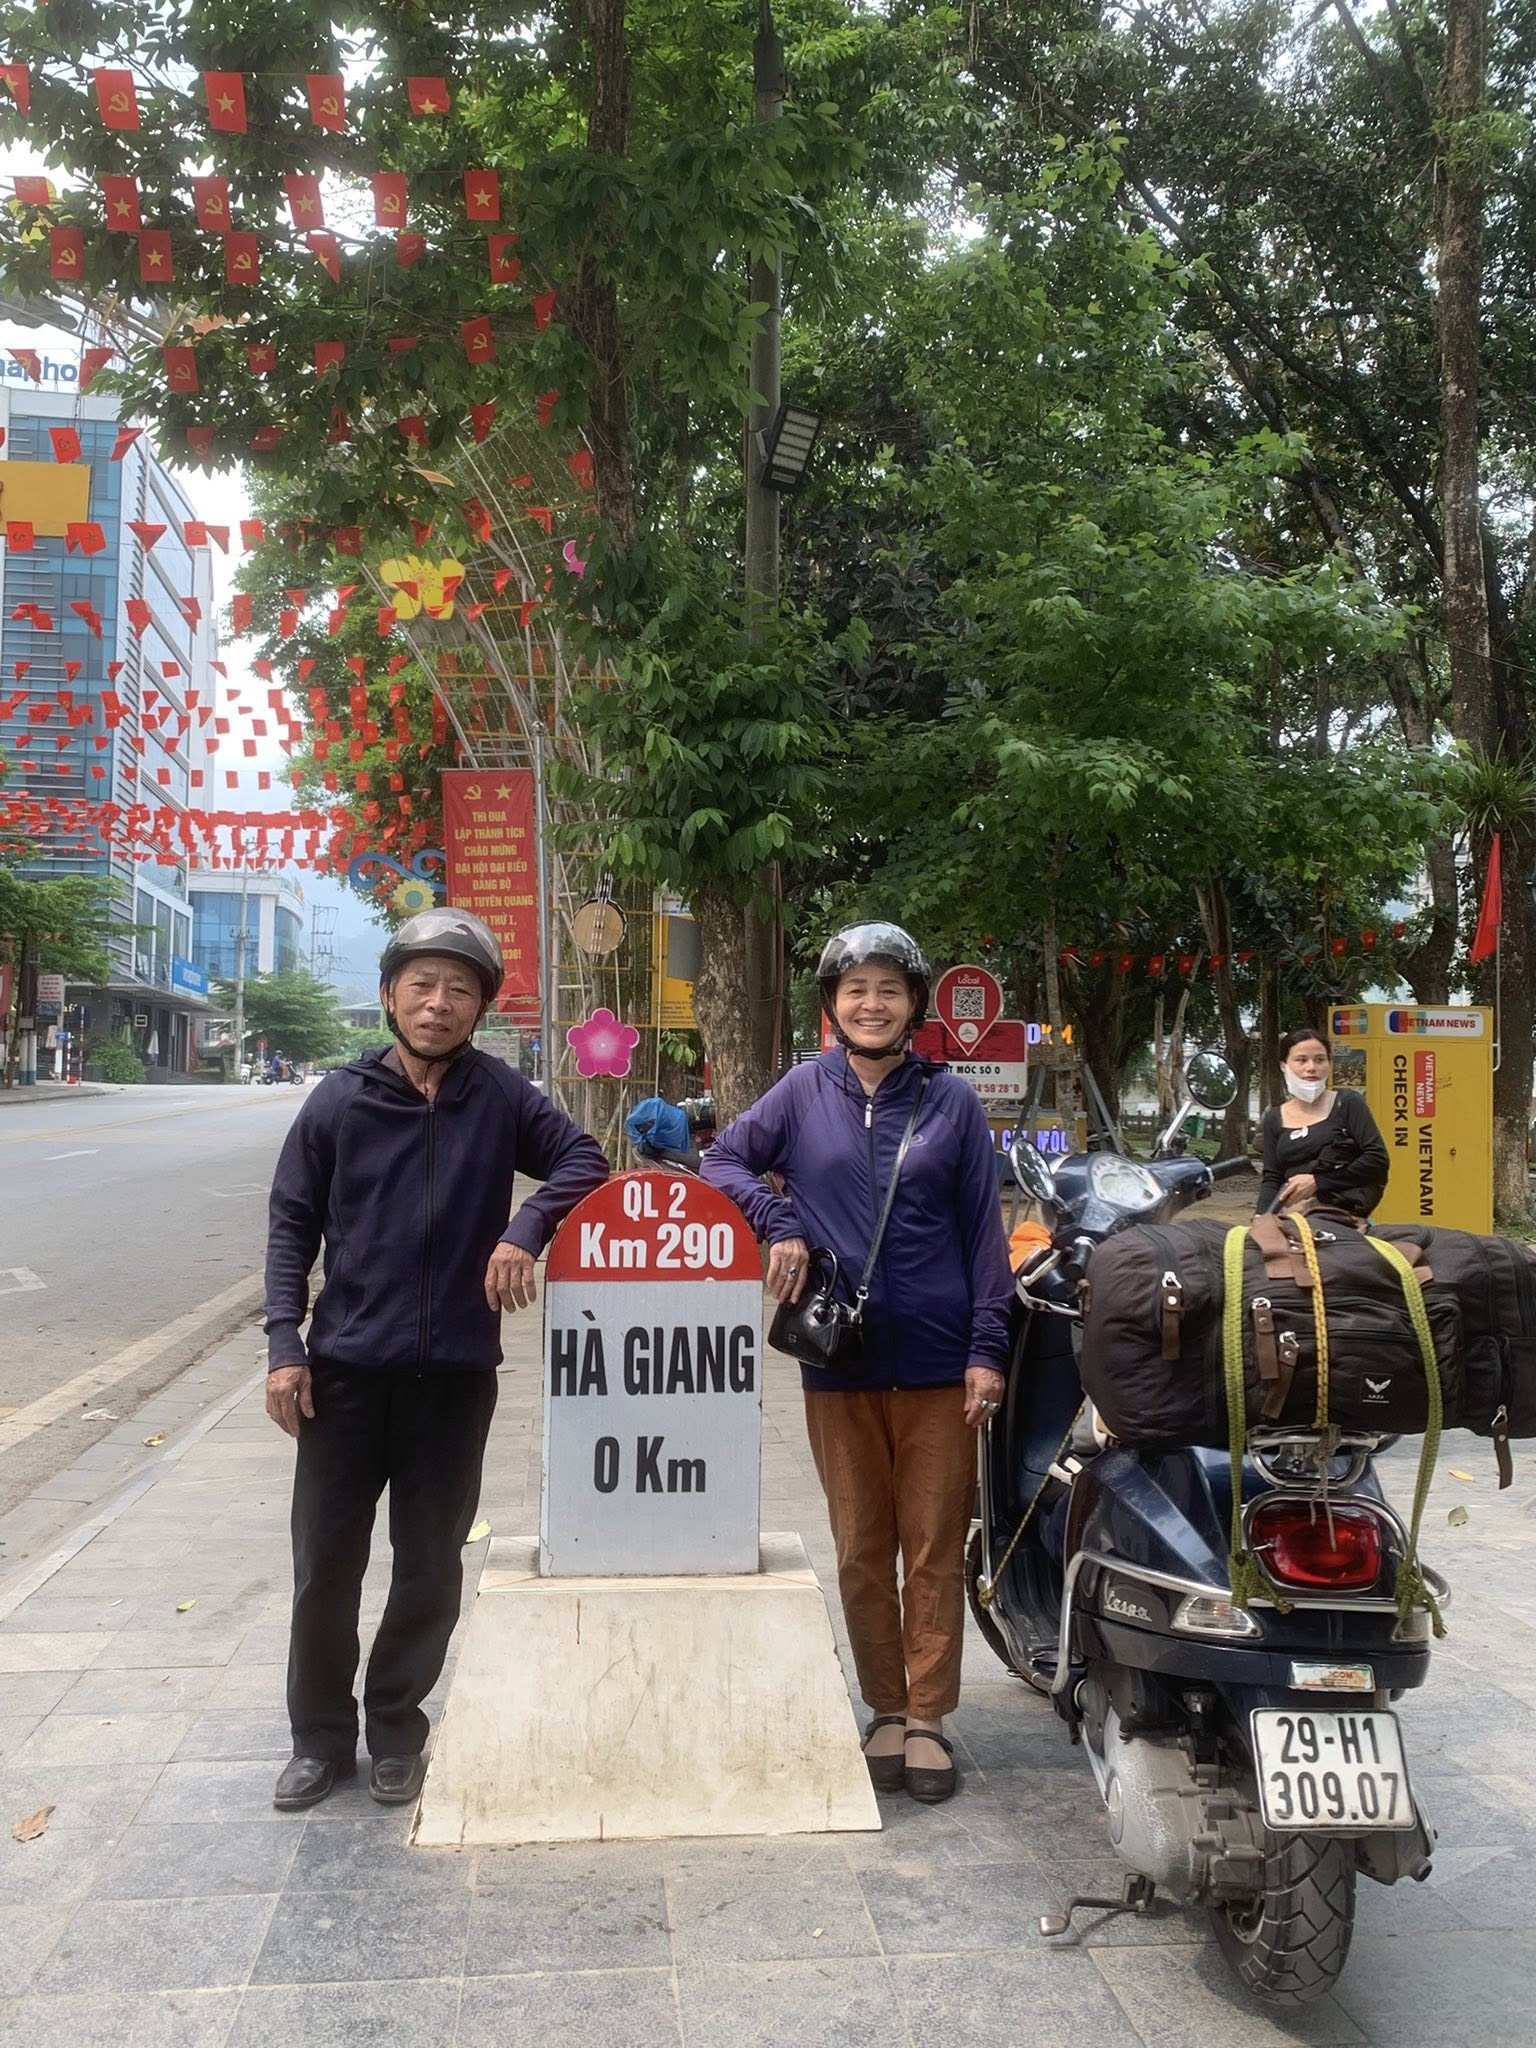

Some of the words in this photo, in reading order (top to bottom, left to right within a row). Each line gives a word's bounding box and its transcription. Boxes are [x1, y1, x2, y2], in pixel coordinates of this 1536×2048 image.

[454, 826, 472, 842] LẬP
[474, 826, 504, 839] THÀNH
[506, 825, 525, 839] TÍCH
[472, 812, 486, 822] THI
[464, 844, 488, 856] CHÀO
[474, 894, 502, 907] TUYÊN
[504, 895, 534, 908] QUANG
[500, 876, 512, 892] BỘ
[1447, 1020, 1476, 1028] NEWS
[1394, 1054, 1408, 1122] CHECK
[1416, 1082, 1424, 1114] NEWS
[1426, 1054, 1434, 1103] VIETNAM
[1395, 1127, 1408, 1147] IN
[1419, 1124, 1433, 1216] VIETNAM
[622, 1180, 659, 1221] QL
[668, 1182, 686, 1219] 2
[580, 1222, 647, 1269] Km
[656, 1222, 734, 1269] 290
[551, 1310, 608, 1397] HÀ
[624, 1325, 755, 1396] GIANG
[594, 1436, 620, 1494] 0
[636, 1436, 706, 1493] Km
[1276, 1716, 1382, 1764] 29-H1
[1270, 1771, 1399, 1820] 309.07
